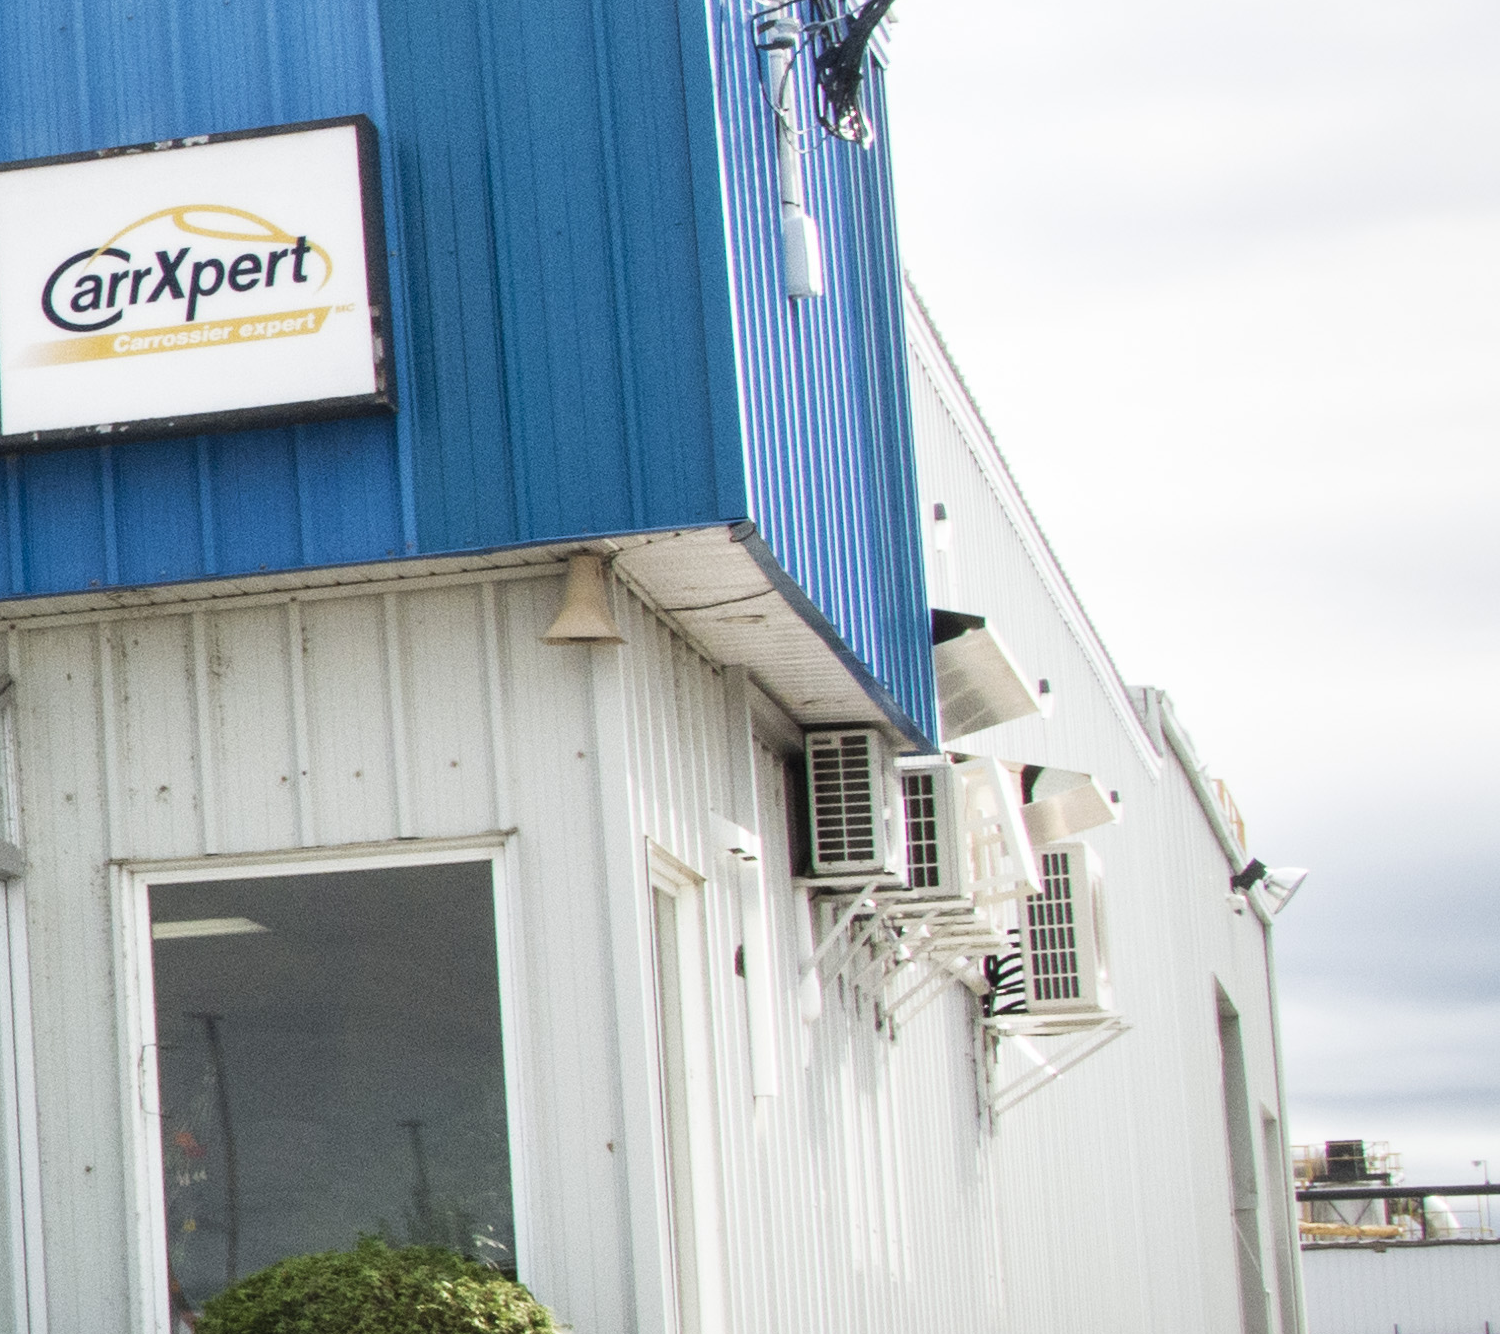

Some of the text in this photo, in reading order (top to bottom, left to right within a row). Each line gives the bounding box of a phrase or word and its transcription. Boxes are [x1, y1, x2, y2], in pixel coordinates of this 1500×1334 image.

[41, 235, 311, 333] CarrXpert
[112, 312, 317, 354] Carrossier expert
